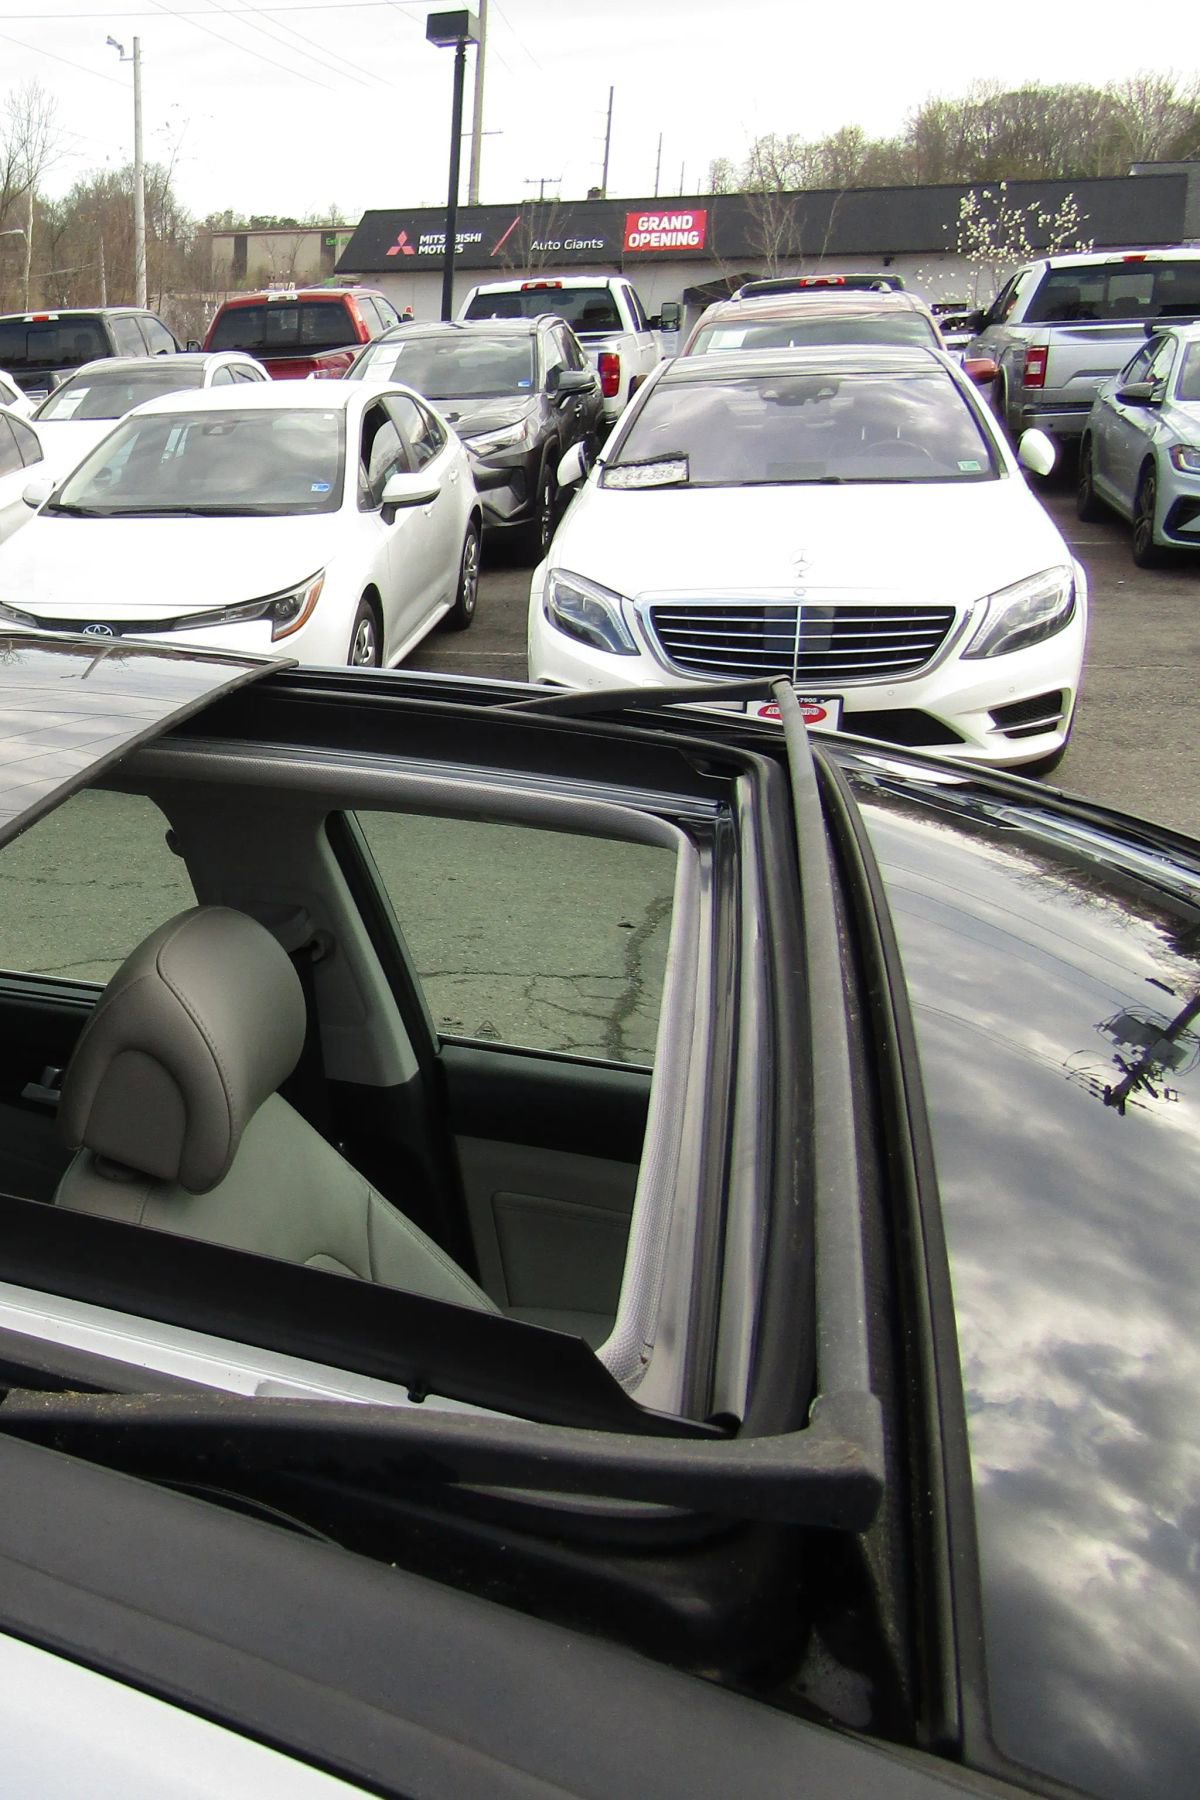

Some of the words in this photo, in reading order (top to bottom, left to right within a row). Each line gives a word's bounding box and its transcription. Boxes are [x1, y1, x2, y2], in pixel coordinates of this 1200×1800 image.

[637, 215, 693, 231] GRAND
[419, 233, 482, 245] MITSBISHI
[530, 240, 561, 251] Auto
[564, 238, 604, 250] Giants
[628, 231, 700, 248] OPENING
